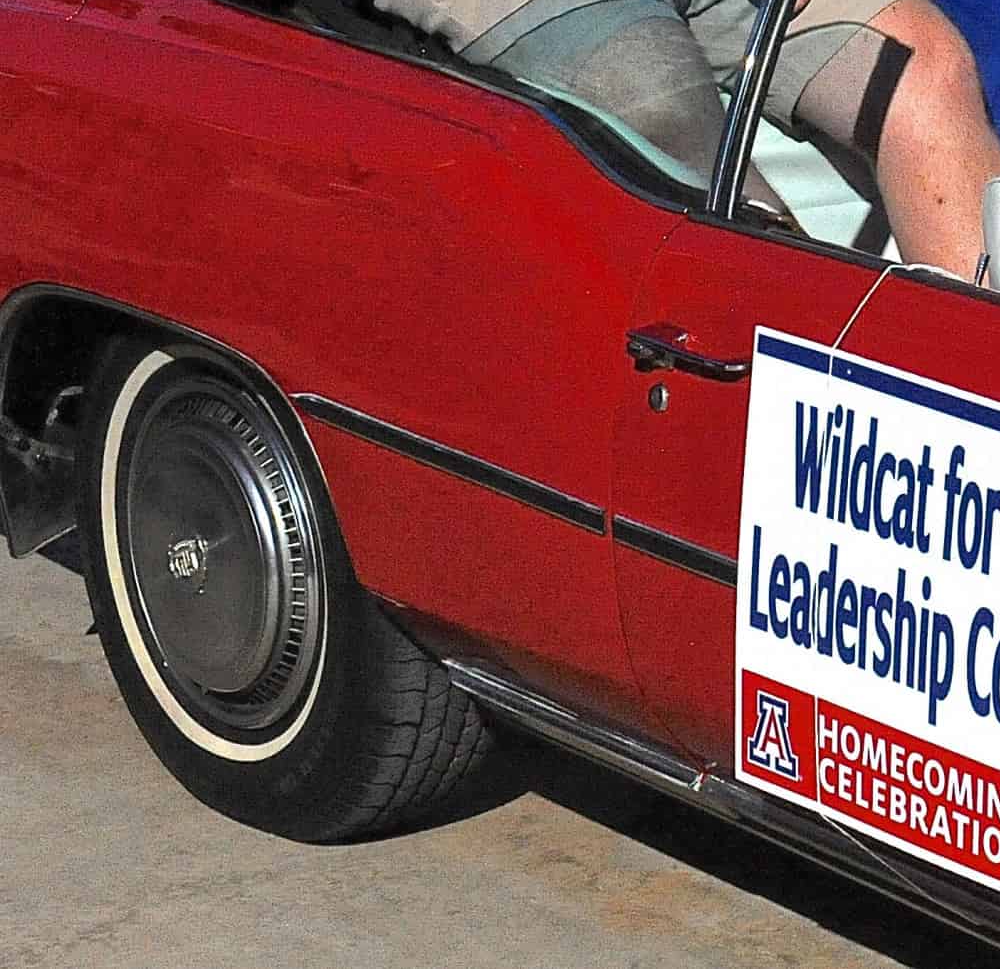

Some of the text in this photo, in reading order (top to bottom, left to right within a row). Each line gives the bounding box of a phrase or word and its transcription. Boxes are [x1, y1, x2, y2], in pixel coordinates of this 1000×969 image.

[795, 400, 935, 554] Wildcat
[750, 524, 955, 727] Leadership
[747, 690, 799, 782] A
